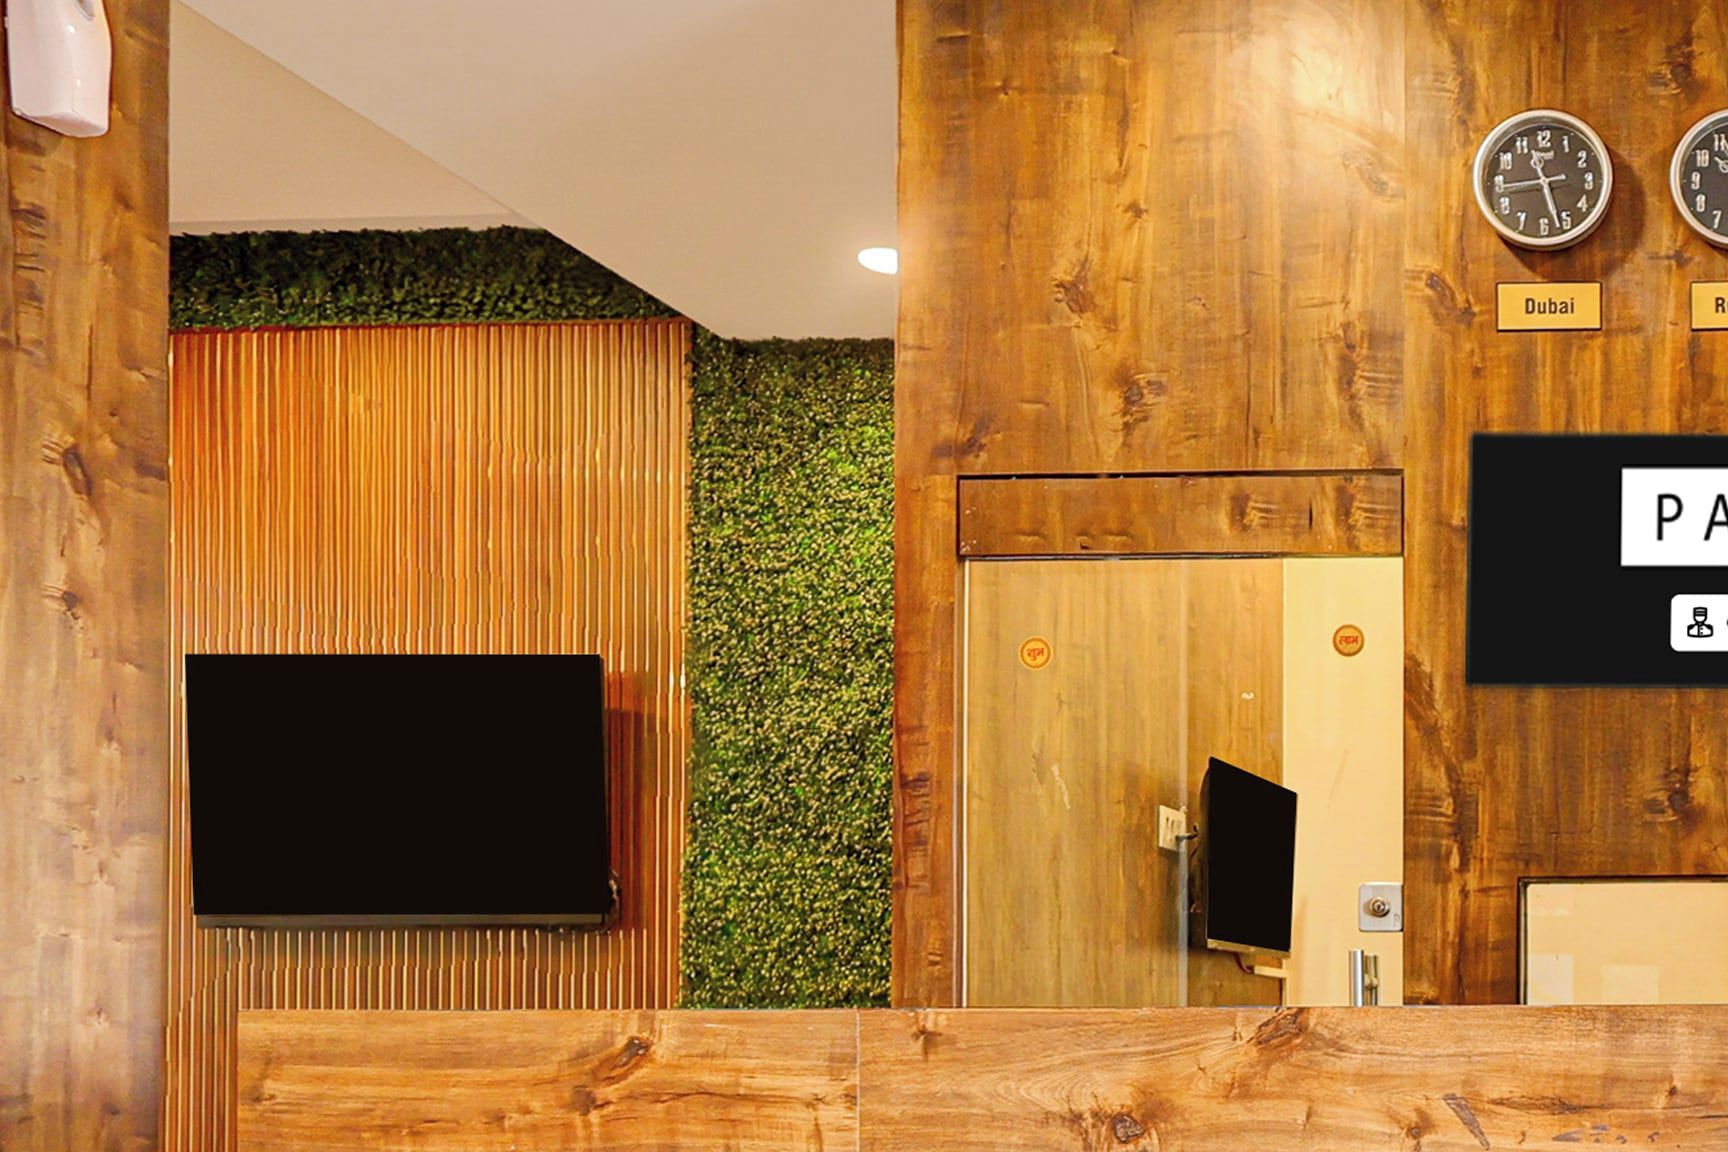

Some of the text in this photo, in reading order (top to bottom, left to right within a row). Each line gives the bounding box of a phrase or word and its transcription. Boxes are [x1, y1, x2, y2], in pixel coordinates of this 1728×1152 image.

[1515, 137, 1528, 153] 11
[1537, 130, 1551, 147] 12
[1563, 136, 1569, 152] 1
[1714, 134, 1726, 151] 11
[1499, 152, 1512, 170] 10
[1577, 150, 1587, 168] 2
[1696, 149, 1709, 167] 10
[1494, 175, 1504, 192] 9
[1584, 172, 1593, 189] 3
[1691, 172, 1700, 189] 9
[1500, 197, 1510, 214] 8
[1576, 195, 1588, 212] 4
[1696, 194, 1705, 212] 8
[1517, 212, 1526, 230] 7
[1539, 218, 1549, 235] 6
[1561, 211, 1571, 229] 5
[1712, 210, 1722, 229] 7
[1525, 297, 1575, 314] Dubai
